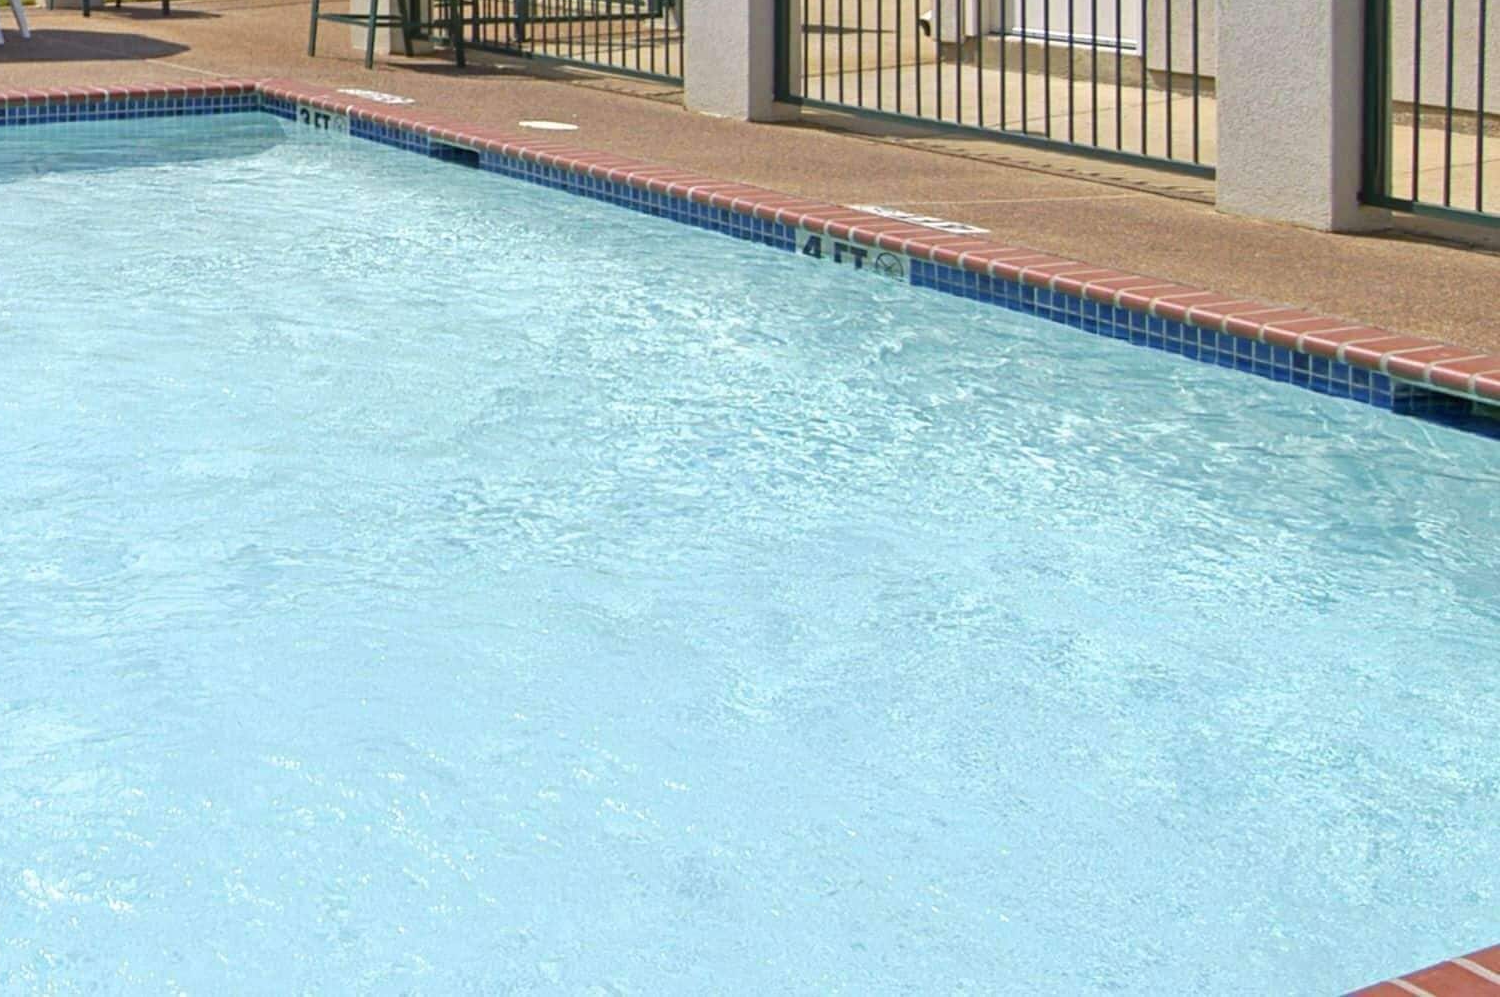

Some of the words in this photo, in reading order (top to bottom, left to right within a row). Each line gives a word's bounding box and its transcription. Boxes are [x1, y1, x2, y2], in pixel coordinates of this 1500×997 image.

[300, 108, 311, 125] 3
[314, 111, 331, 130] FT
[802, 235, 822, 260] 4
